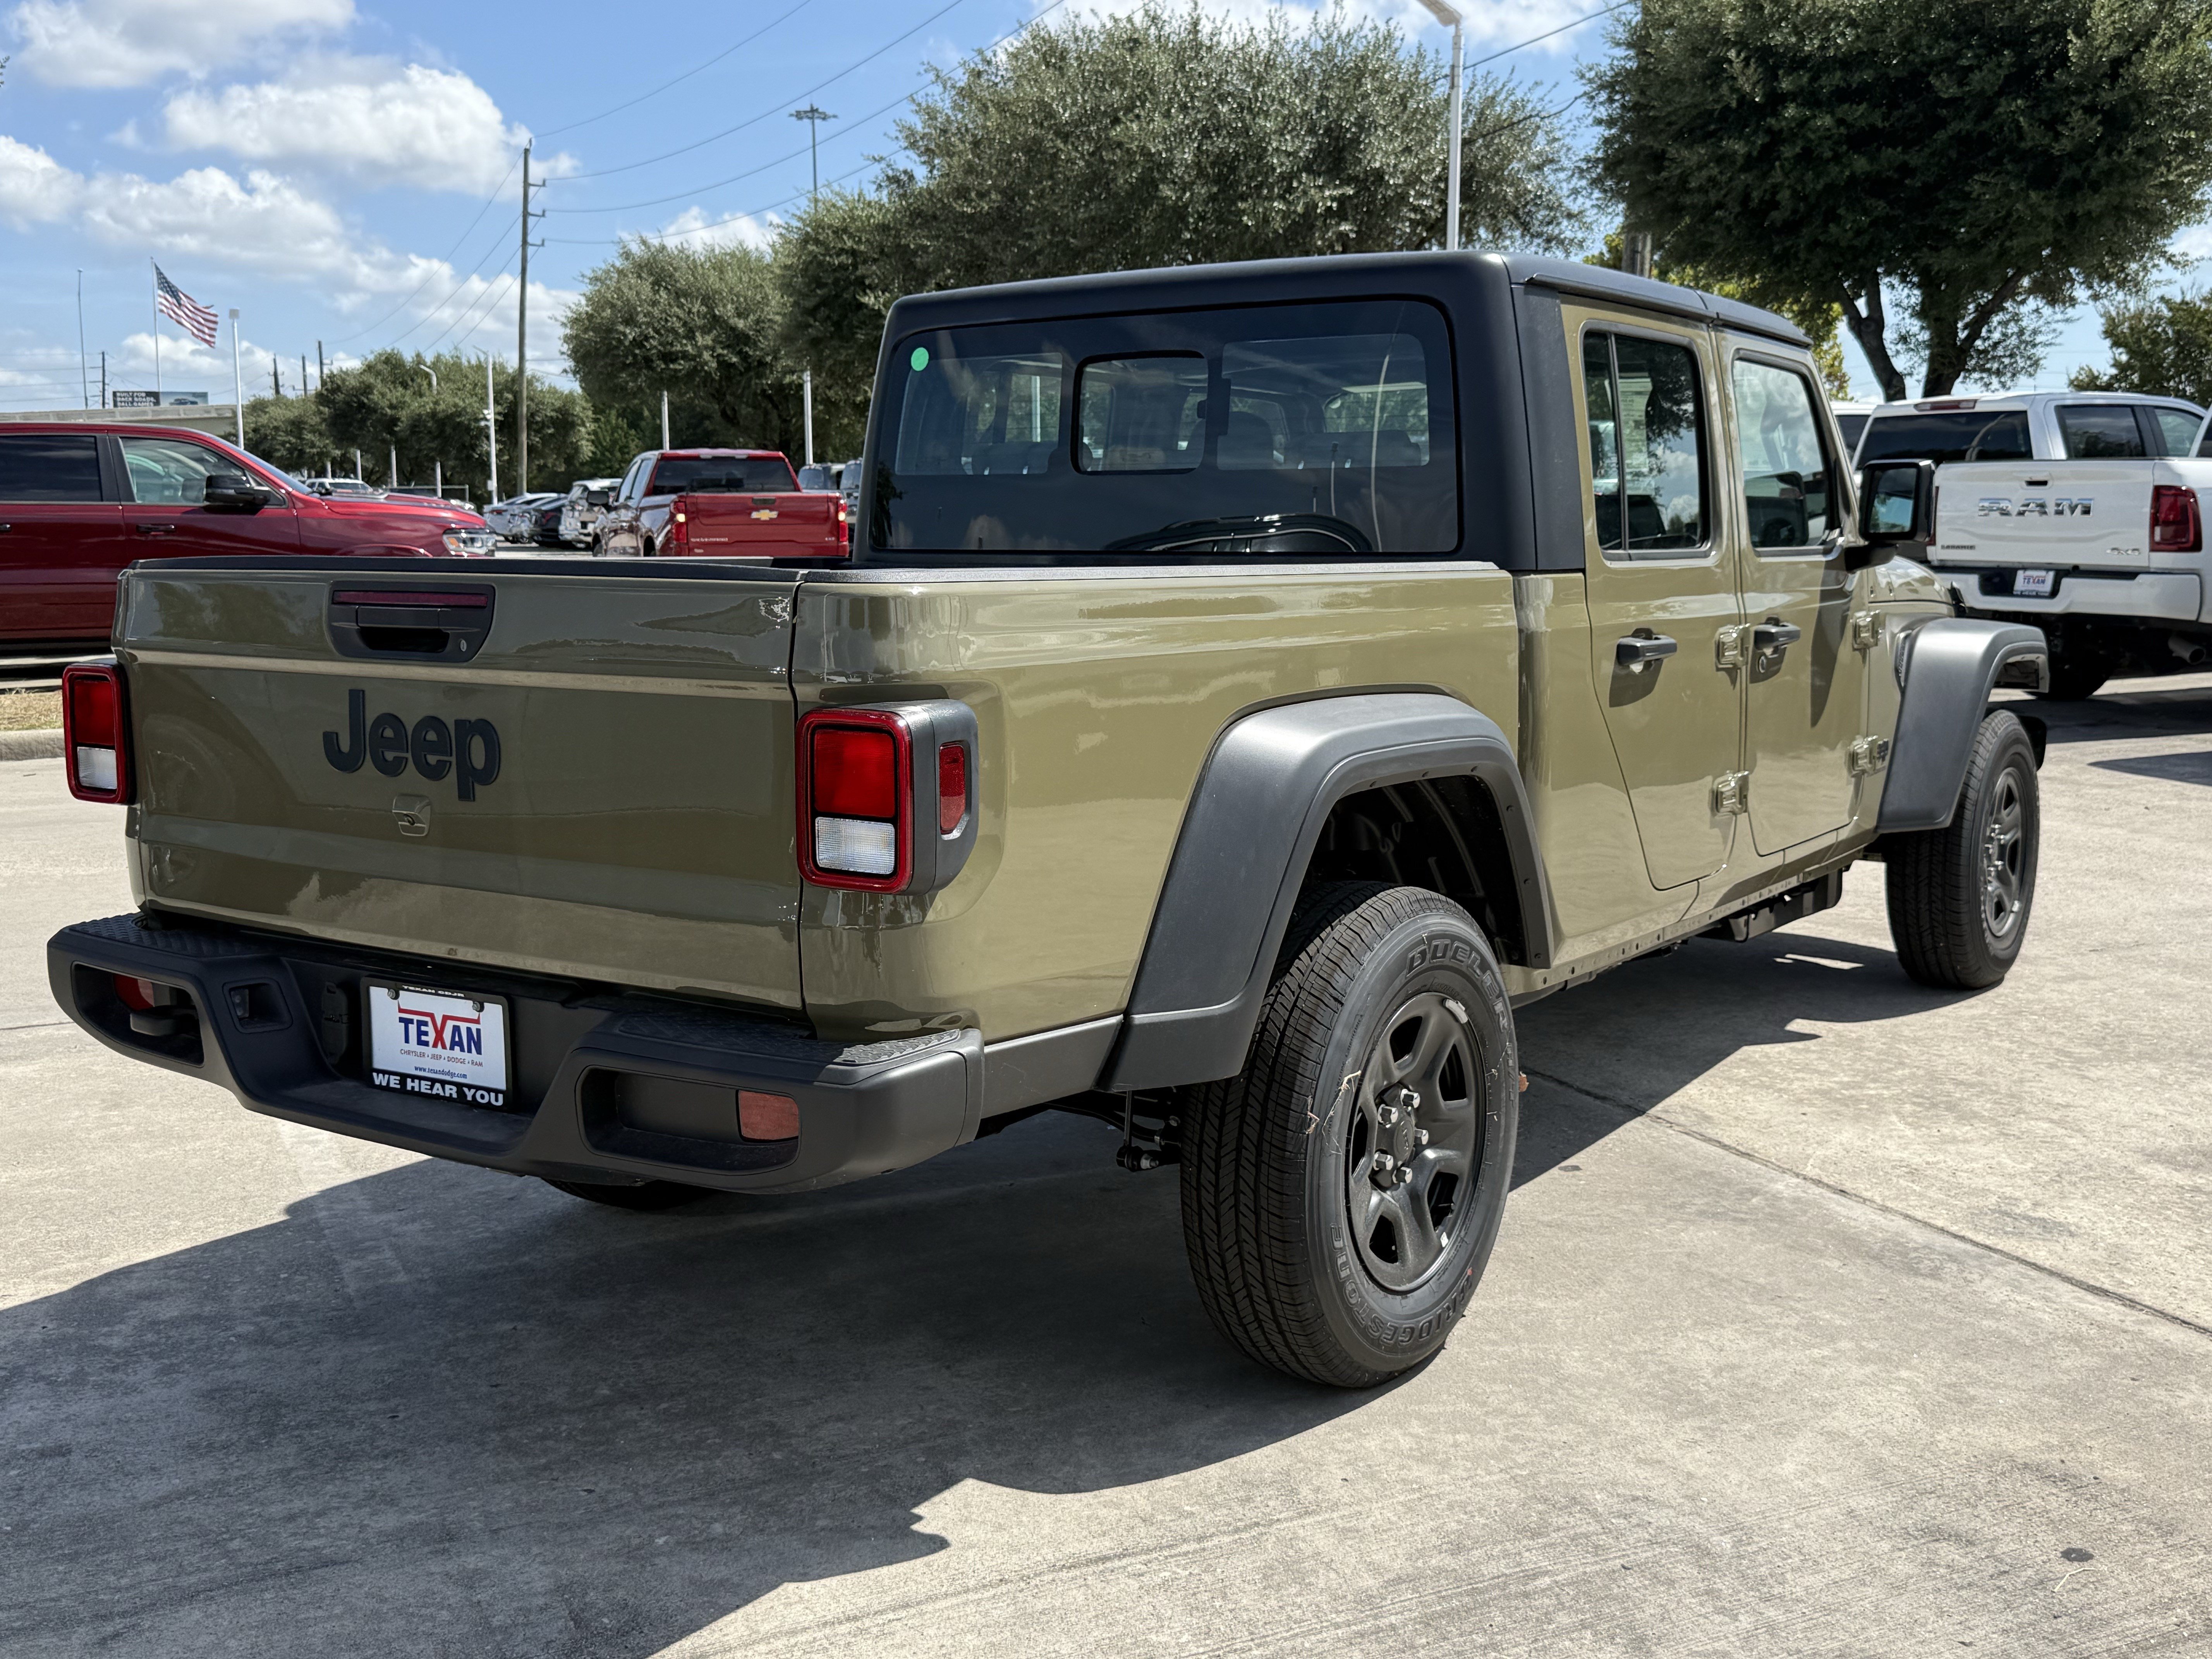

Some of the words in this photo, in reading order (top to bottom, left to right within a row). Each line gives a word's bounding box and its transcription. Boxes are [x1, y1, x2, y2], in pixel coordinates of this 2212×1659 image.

[1978, 498, 2094, 517] RAM
[323, 689, 501, 801] Jeep
[402, 985, 435, 993] TEXAN
[1405, 939, 1509, 1032] DUELER
[398, 1008, 482, 1055] TEXAN
[400, 1049, 426, 1058] CHRYSLER
[447, 1056, 466, 1065] DODGE
[414, 1066, 467, 1079] www.texandodge.com
[373, 1072, 400, 1089] WE
[407, 1078, 457, 1098] HEAR
[462, 1087, 503, 1106] YOU
[1330, 1223, 1472, 1348] BRIDGESTONE
